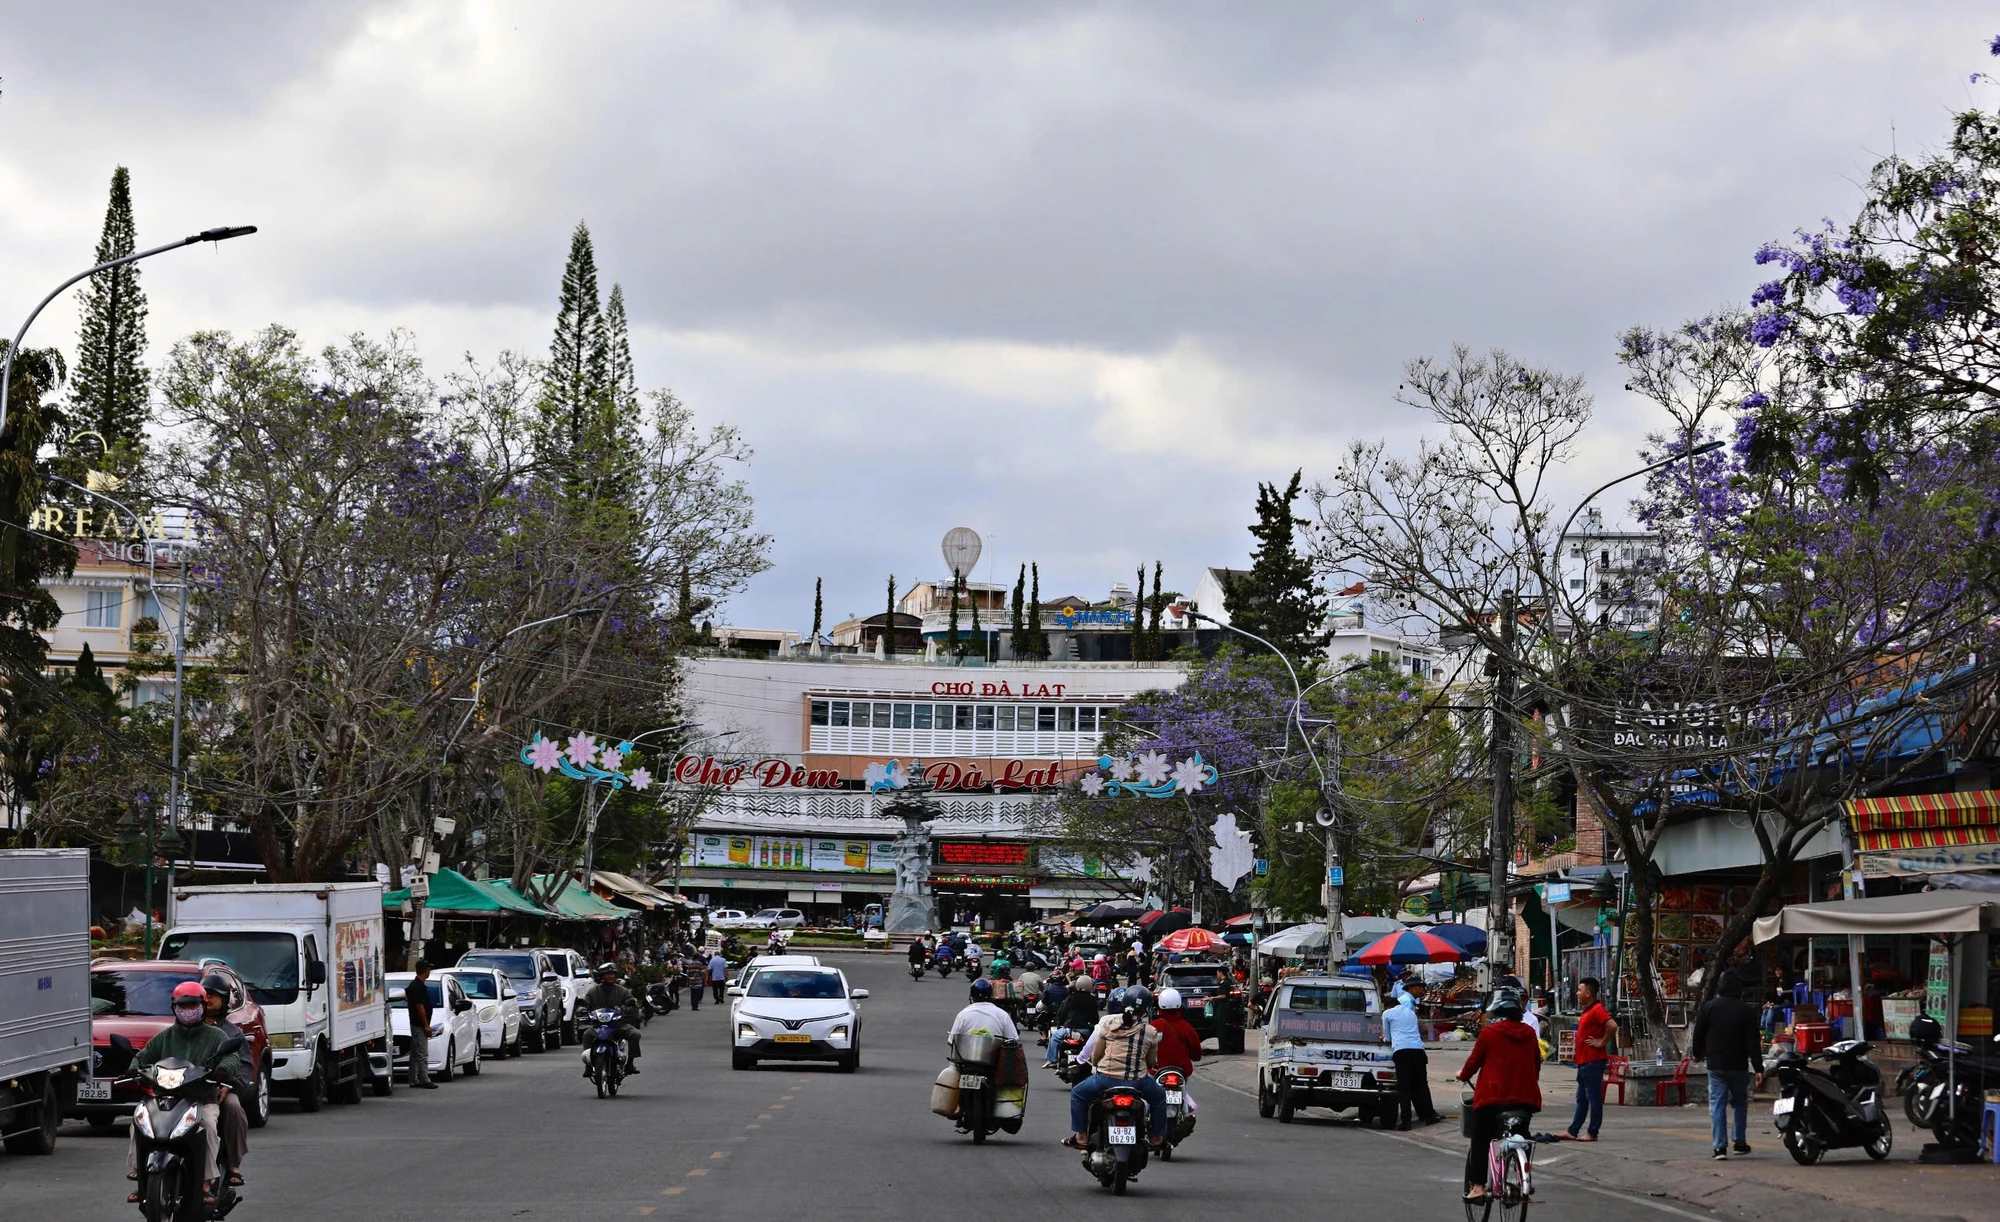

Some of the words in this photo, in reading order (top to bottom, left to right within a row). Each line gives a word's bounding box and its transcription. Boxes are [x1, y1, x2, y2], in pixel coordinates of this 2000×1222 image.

[932, 681, 974, 698] CHỢ
[982, 680, 1013, 697] ĐÀ
[1022, 684, 1066, 700] LẠT
[675, 755, 745, 791] Chợ
[753, 759, 844, 789] Đêm
[922, 760, 987, 792] Đà
[992, 759, 1063, 794] Lạt
[1281, 1018, 1309, 1031] PHƯƠNG
[1310, 1018, 1326, 1033] TIỆN
[1327, 1020, 1342, 1032] LƯU
[1342, 1021, 1361, 1034] ĐỘNG
[1324, 1050, 1375, 1062] SUZUKI
